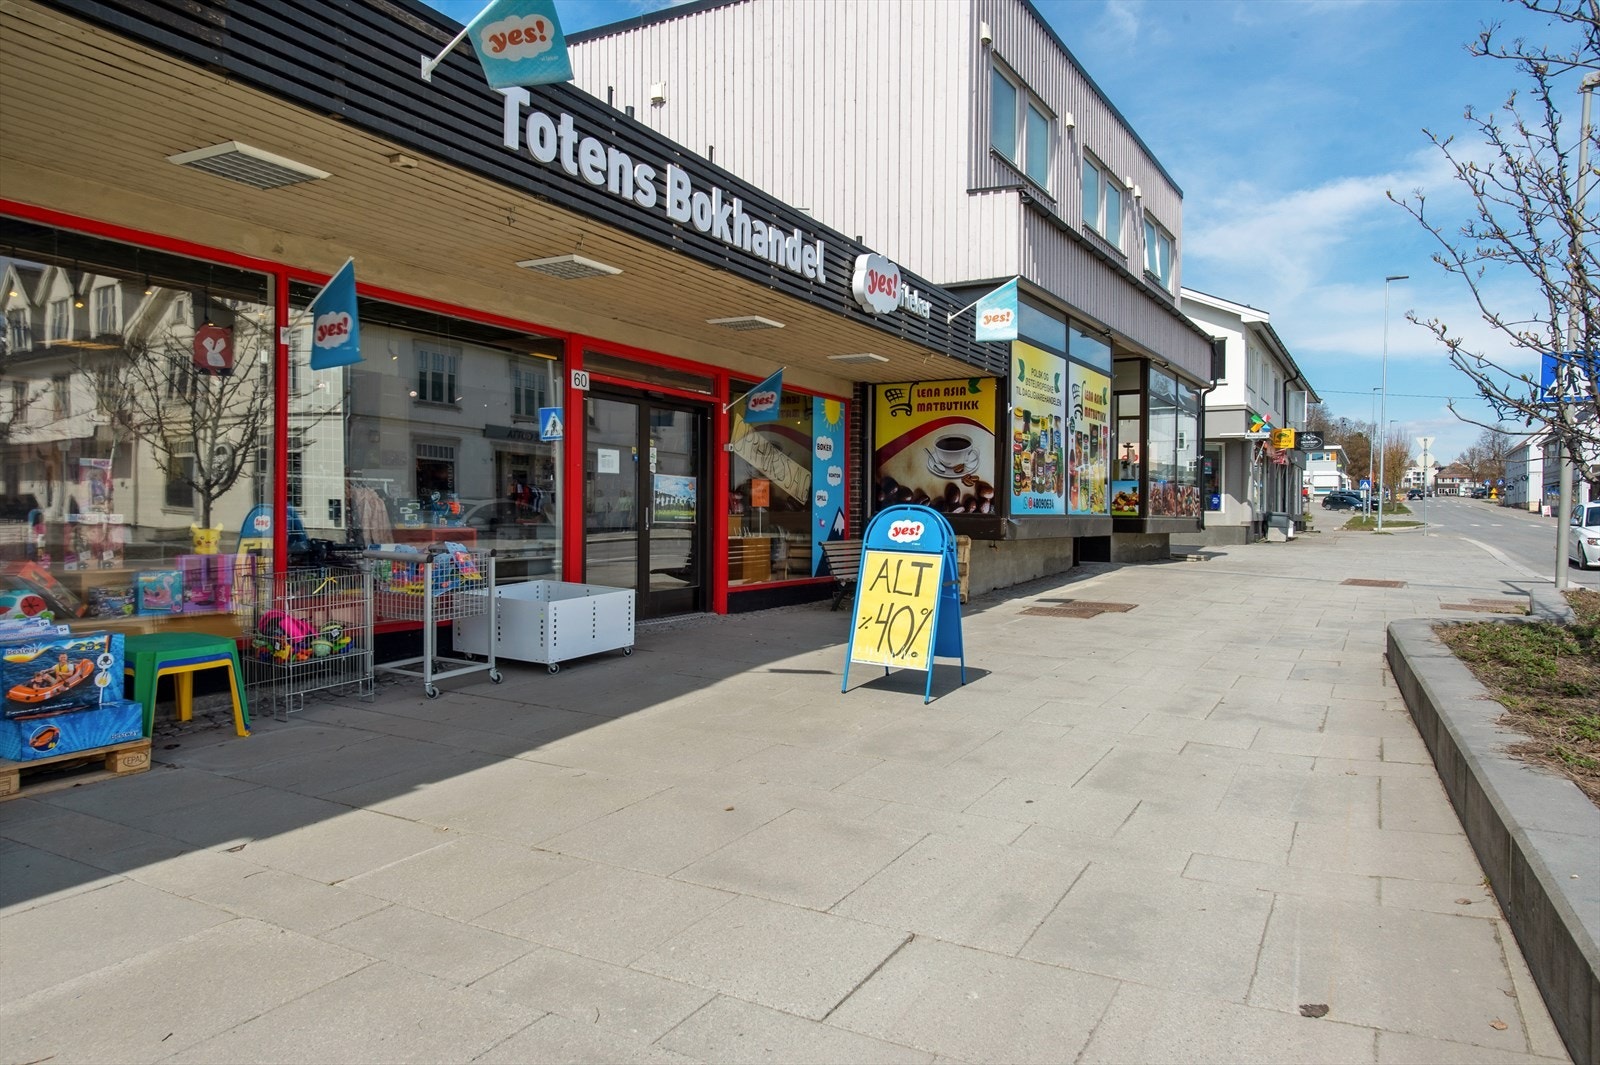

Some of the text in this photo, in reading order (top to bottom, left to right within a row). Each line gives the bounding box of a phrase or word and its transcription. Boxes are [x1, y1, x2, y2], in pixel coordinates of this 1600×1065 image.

[489, 20, 547, 53] yes!
[496, 86, 826, 284] Totens Bokhandel
[867, 268, 898, 299] yes!
[983, 311, 1011, 325] yes!
[317, 317, 348, 342] yes!
[574, 372, 587, 388] 60
[917, 386, 966, 398] LENA ASIA
[751, 394, 775, 407] yes!
[917, 400, 979, 412] MATBUTIKK
[892, 525, 921, 537] yes!
[869, 558, 933, 597] ALT
[127, 755, 144, 764] EPAL
